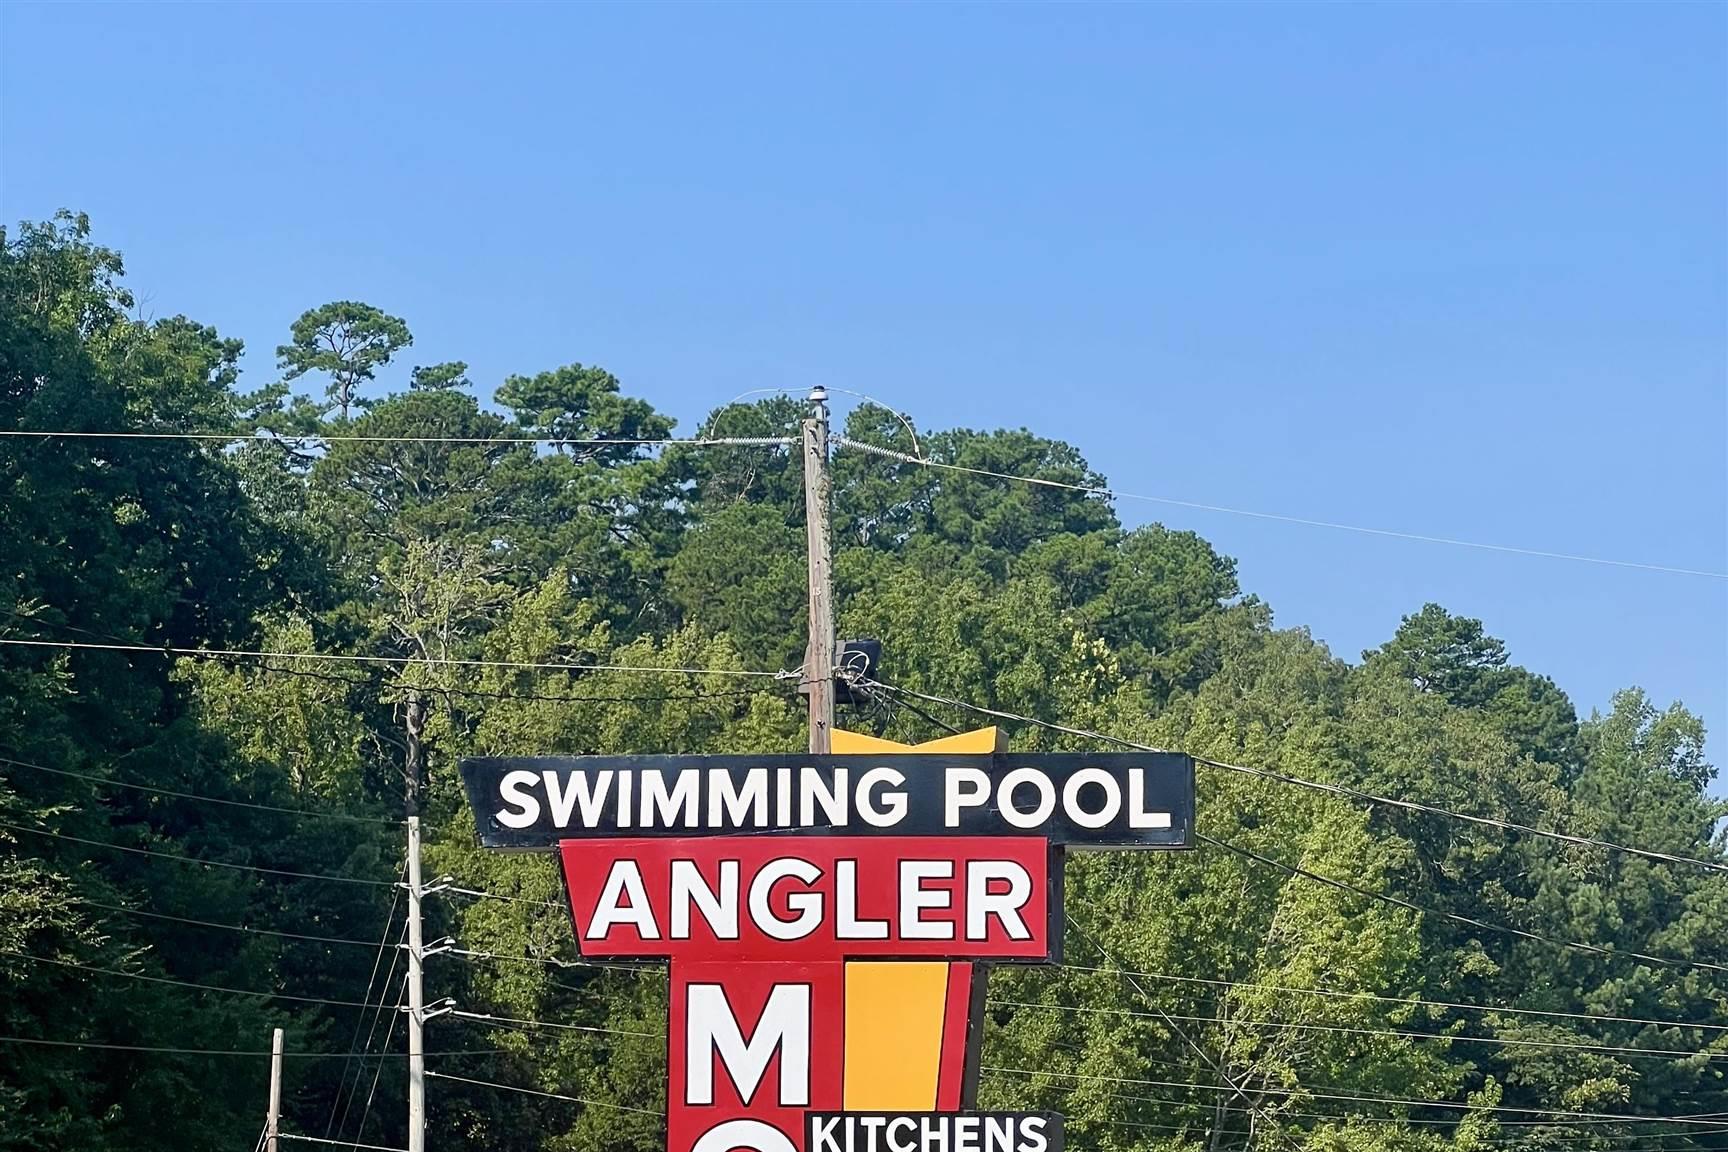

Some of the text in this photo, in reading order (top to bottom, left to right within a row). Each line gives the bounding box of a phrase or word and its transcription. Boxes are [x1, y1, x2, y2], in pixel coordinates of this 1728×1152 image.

[495, 766, 1171, 830] SWIMMING POOL
[585, 857, 1032, 941] ANGLER
